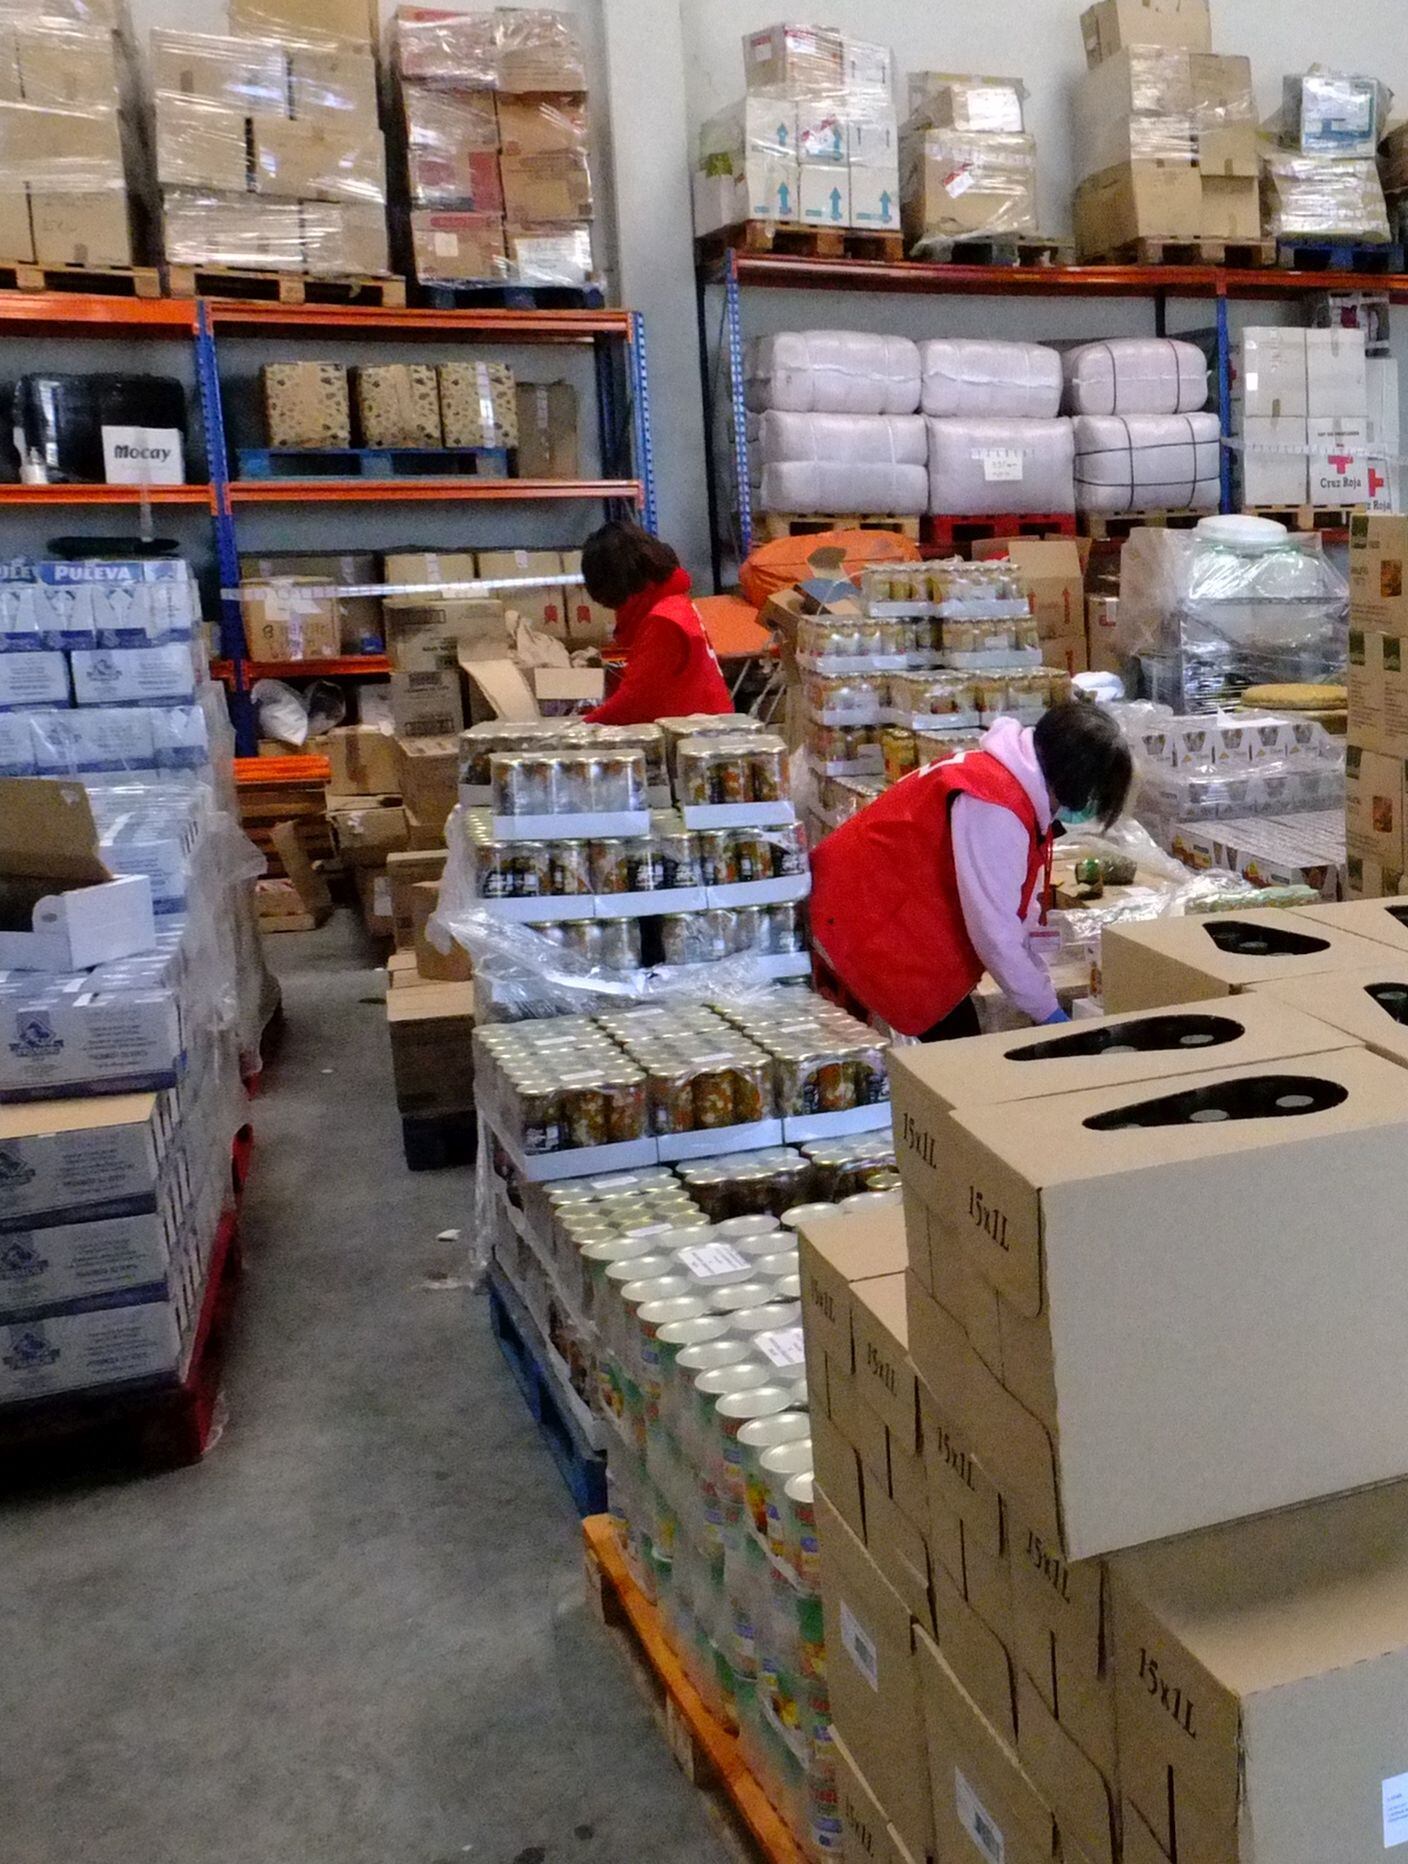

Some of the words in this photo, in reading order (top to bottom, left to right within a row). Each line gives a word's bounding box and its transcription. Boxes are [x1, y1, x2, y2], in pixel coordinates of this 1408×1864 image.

[114, 444, 171, 463] Mocay
[1320, 477, 1341, 488] Cruz
[1343, 476, 1362, 490] Roja
[54, 566, 132, 581] PULEVA
[903, 1112, 937, 1169] 15x1L
[969, 1185, 1009, 1252] 15x1L
[937, 1426, 975, 1492] 15x1L
[1027, 1530, 1070, 1604] 15x1L
[1139, 1647, 1196, 1740] 15x1L
